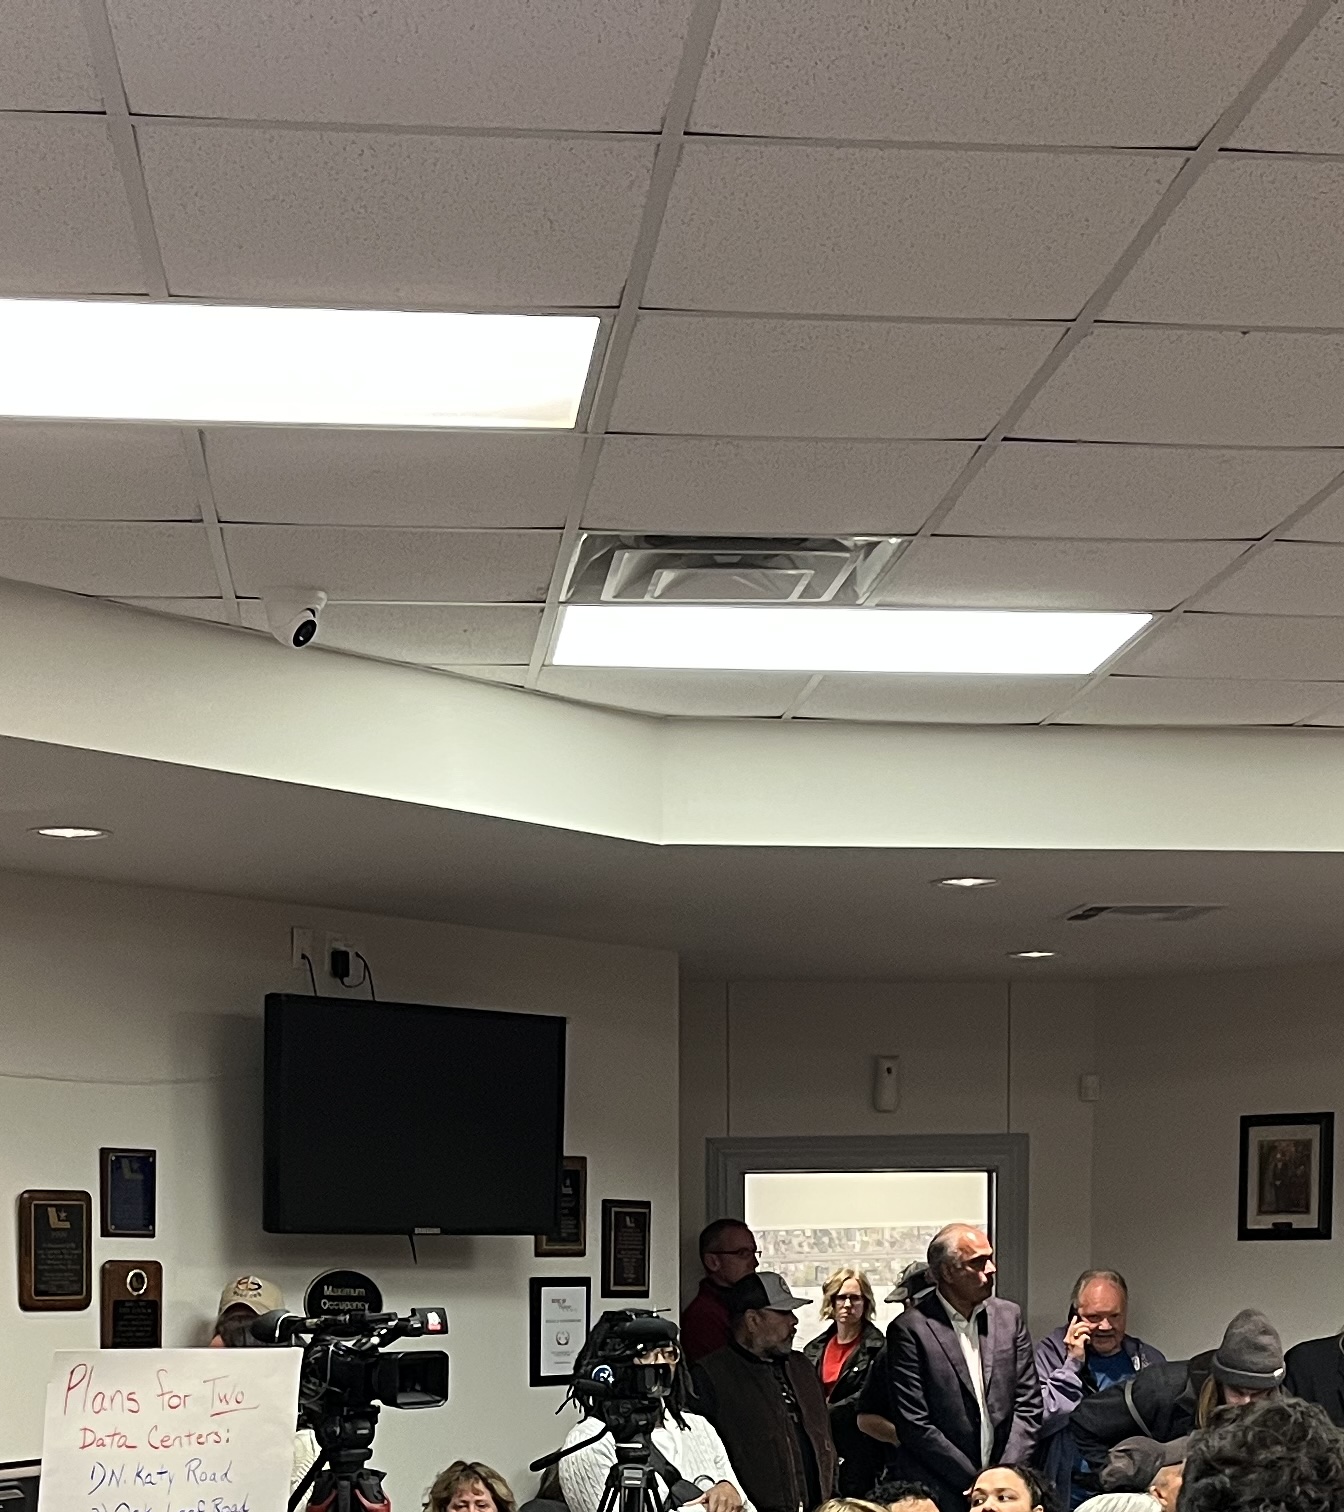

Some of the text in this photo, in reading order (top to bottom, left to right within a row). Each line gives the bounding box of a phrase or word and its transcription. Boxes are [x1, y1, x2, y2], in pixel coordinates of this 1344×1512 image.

[323, 1284, 366, 1298] Maximum
[320, 1299, 370, 1313] Occupancy
[63, 1363, 246, 1415] Plans for Two
[78, 1424, 231, 1450] Data Centers:
[133, 1463, 175, 1495] Katy
[184, 1457, 233, 1485] Road
